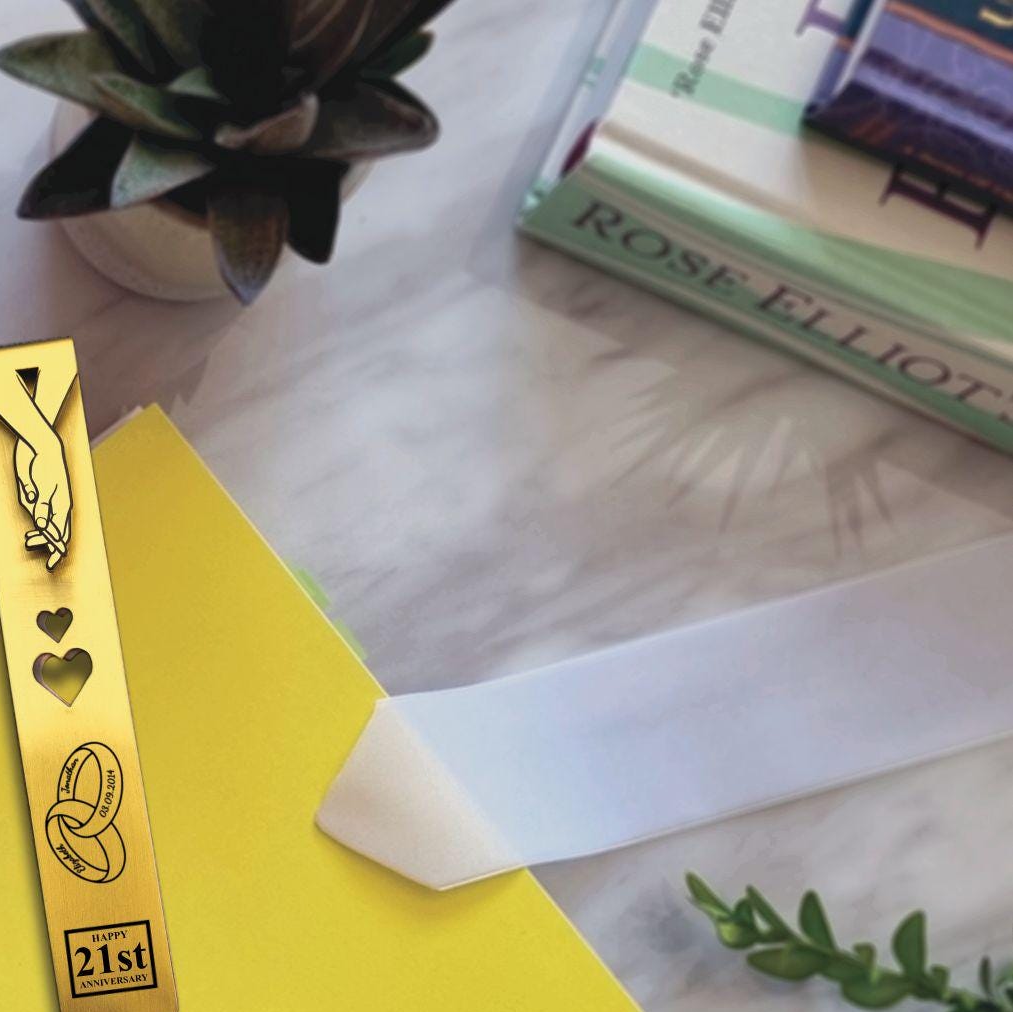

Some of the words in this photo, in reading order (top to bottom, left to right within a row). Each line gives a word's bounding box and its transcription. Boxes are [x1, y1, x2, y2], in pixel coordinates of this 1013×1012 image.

[572, 201, 750, 290] ROSE
[61, 758, 79, 794] Jonathan
[99, 769, 116, 818] 03.09.2014
[56, 843, 86, 873] Elizabeth
[92, 930, 128, 942] HAPPY
[75, 942, 148, 977] 21st
[80, 974, 148, 989] ANNIVERSARY
